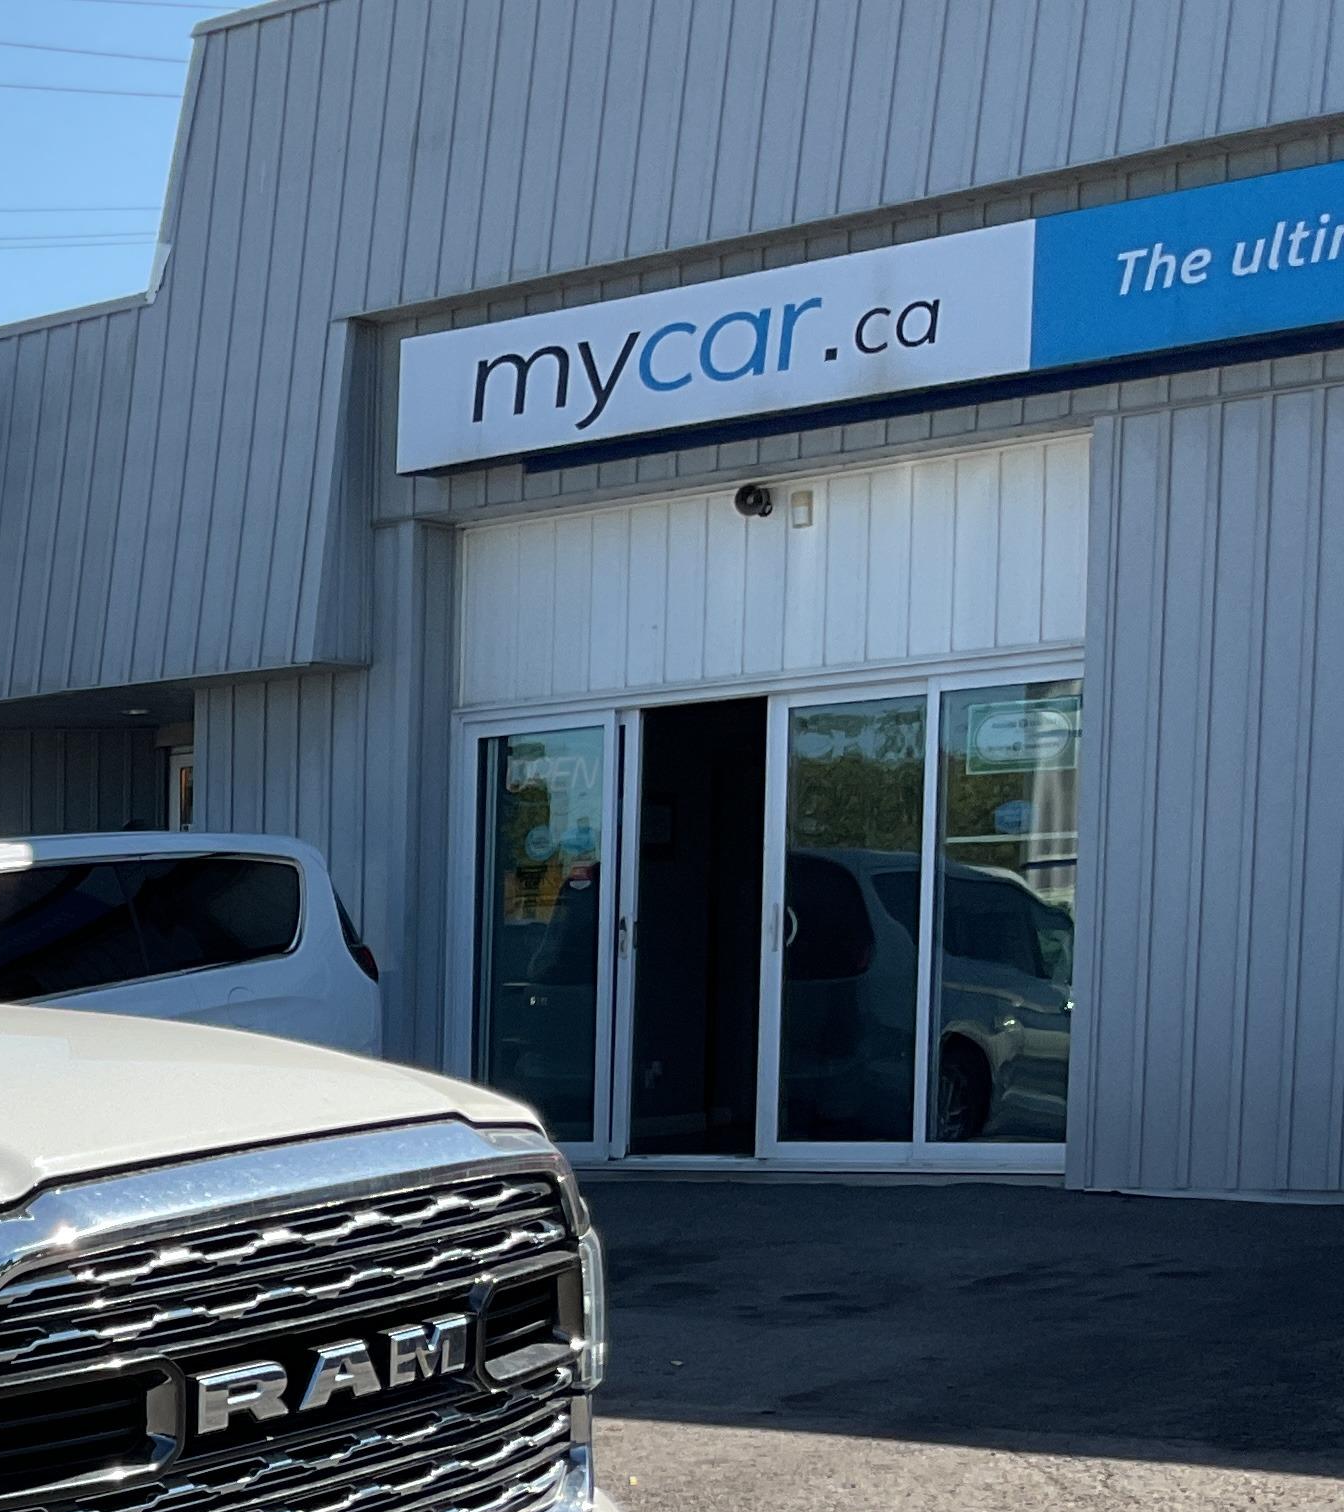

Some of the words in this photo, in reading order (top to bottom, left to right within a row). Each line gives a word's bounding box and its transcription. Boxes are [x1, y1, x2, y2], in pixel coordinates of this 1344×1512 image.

[1118, 243, 1212, 296] The
[472, 297, 941, 430] mycar.ca
[195, 1311, 470, 1435] RAM
